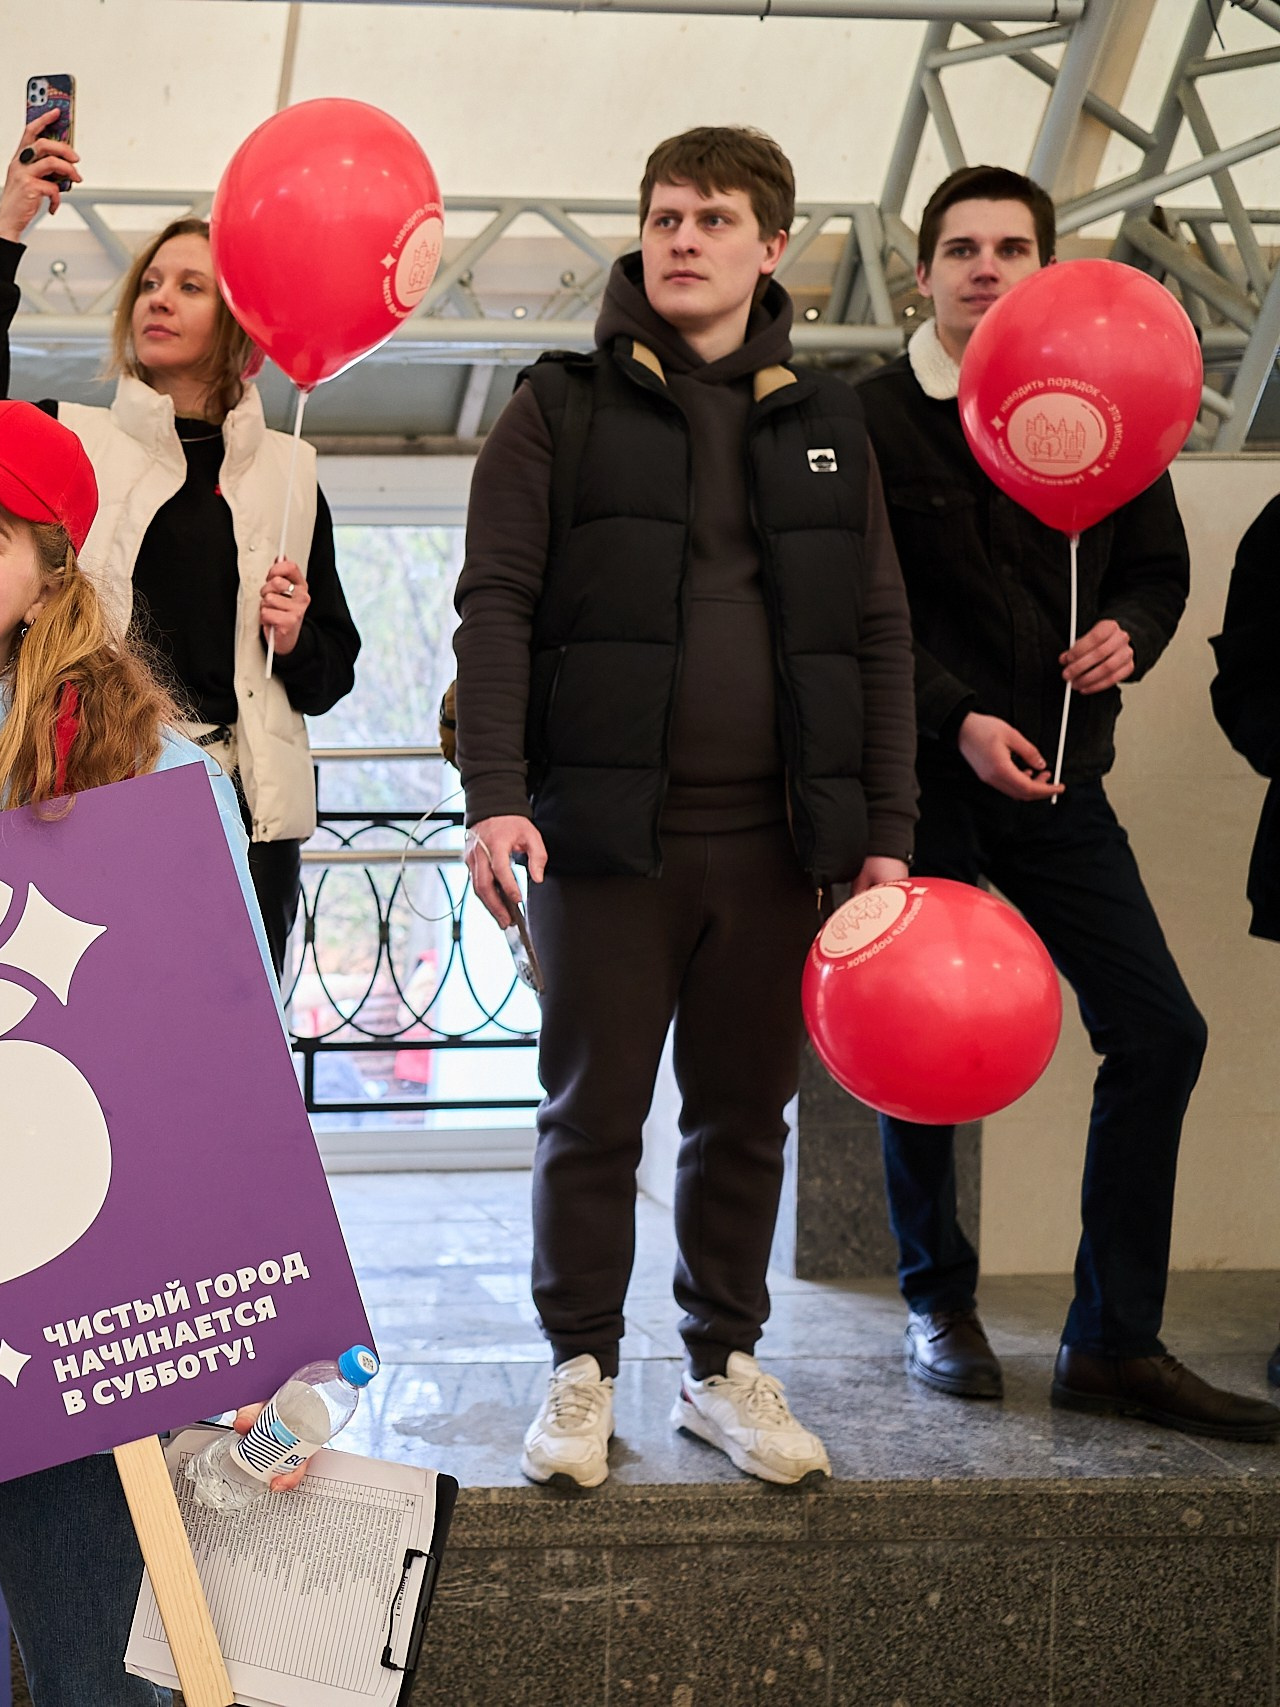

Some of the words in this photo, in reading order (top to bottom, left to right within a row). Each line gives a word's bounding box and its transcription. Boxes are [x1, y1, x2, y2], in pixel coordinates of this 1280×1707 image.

[1047, 377, 1101, 398] порядок
[847, 936, 894, 970] порядок
[42, 1279, 191, 1348] ЧИСТЫЙ
[195, 1251, 311, 1305] ГОРОД
[52, 1295, 278, 1384] НАЧИНАЕТСЯ
[61, 1388, 87, 1416] В
[91, 1336, 257, 1406] СУББОТУ!
